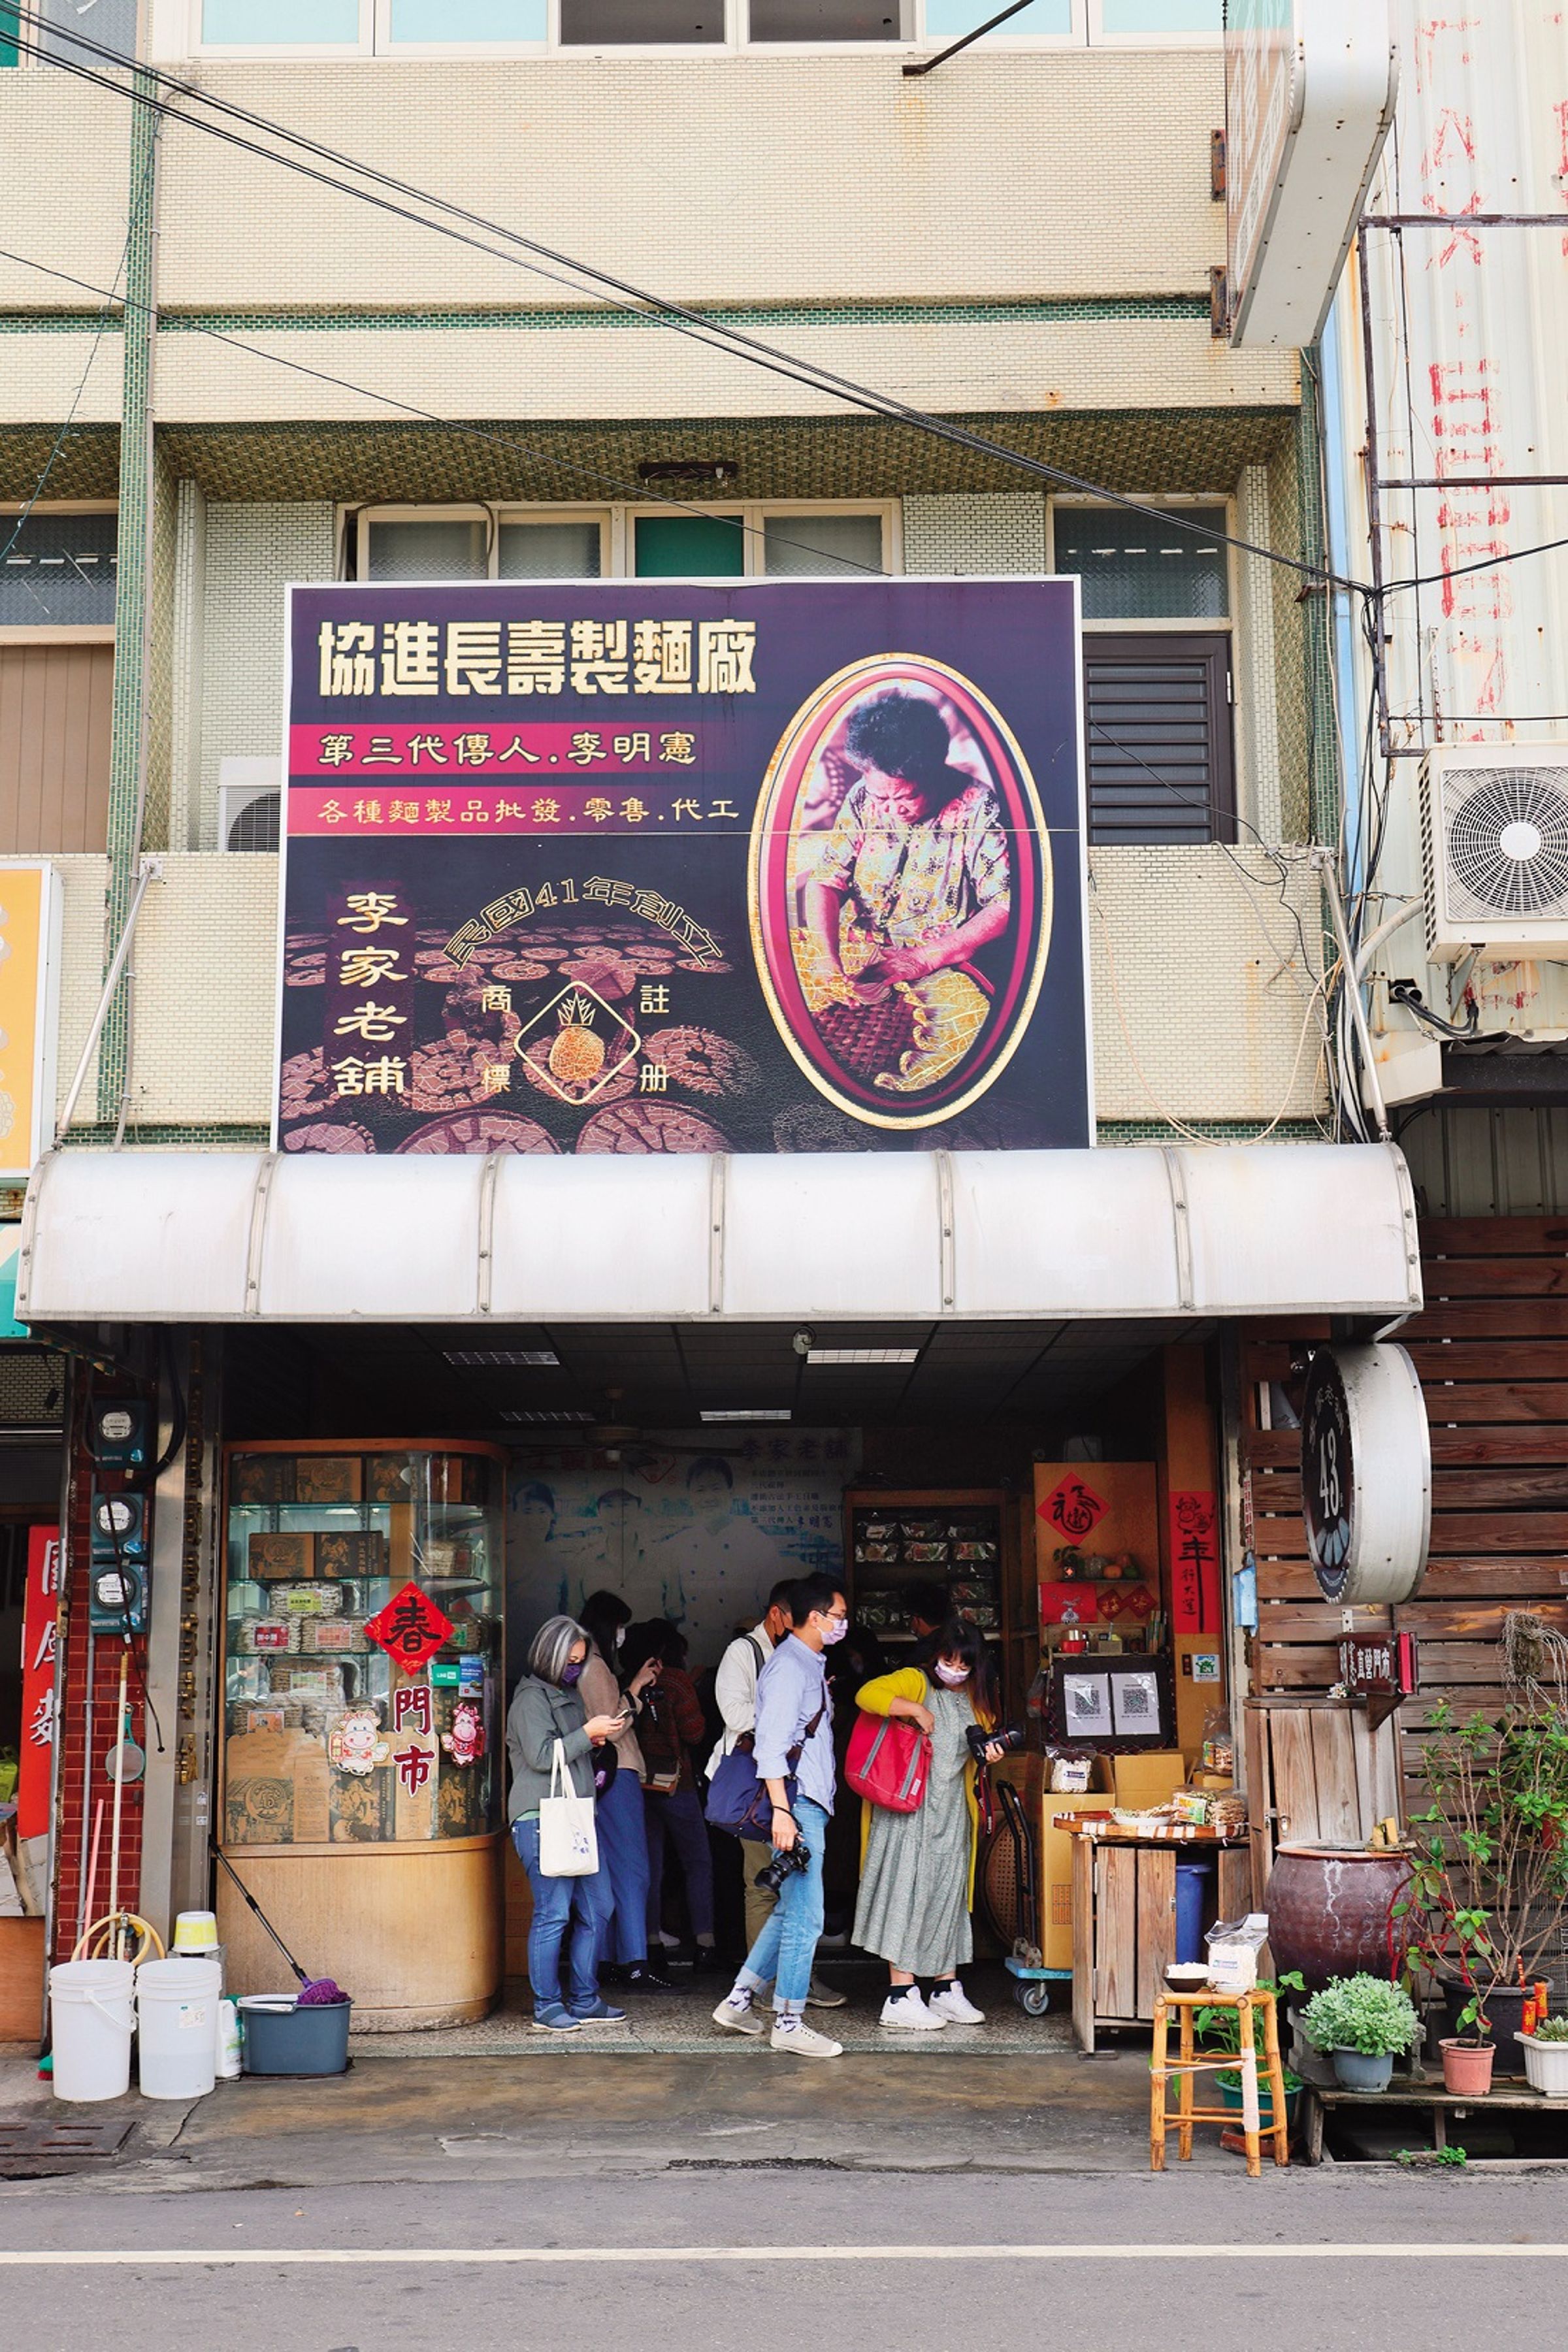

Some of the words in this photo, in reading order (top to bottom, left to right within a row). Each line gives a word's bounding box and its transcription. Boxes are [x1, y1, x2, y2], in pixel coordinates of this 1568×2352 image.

[318, 619, 757, 696] 協進長壽製麵廠
[442, 875, 723, 970] 民國41年創立
[331, 890, 409, 1096] 李家老舖
[384, 1595, 442, 1653] 春
[392, 1684, 436, 1798] 門市
